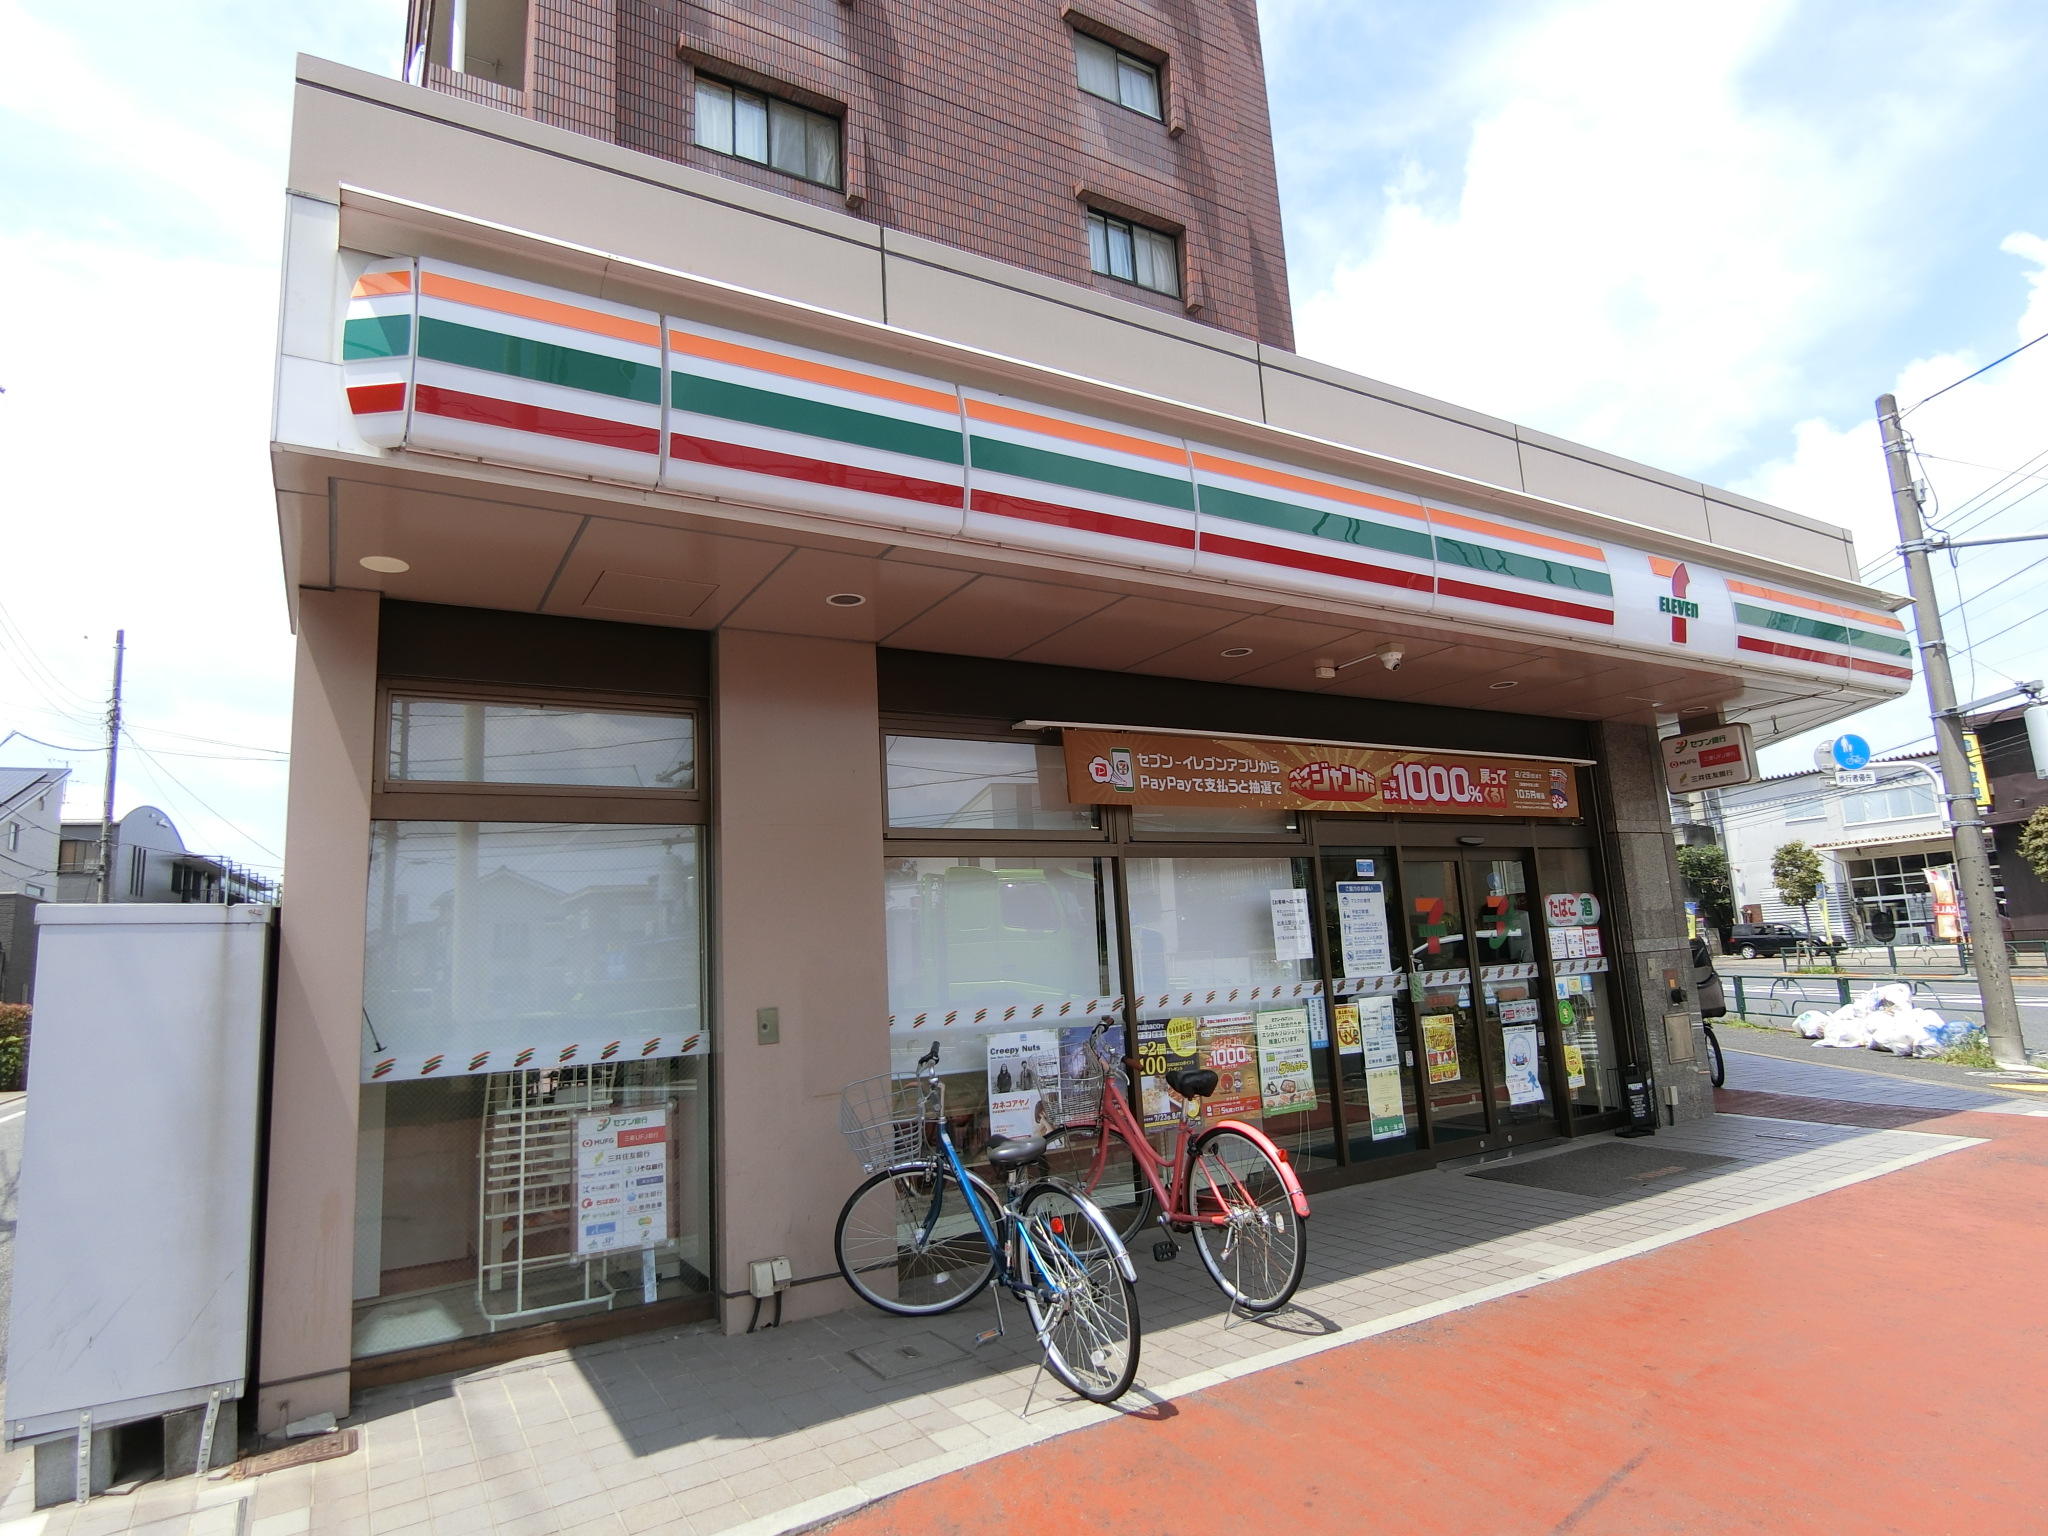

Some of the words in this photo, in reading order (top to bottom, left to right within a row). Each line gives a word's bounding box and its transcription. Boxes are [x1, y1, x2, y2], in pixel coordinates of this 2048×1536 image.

[1480, 768, 1507, 785] 戻って
[1838, 771, 1873, 784] 歩行者優先
[1140, 775, 1282, 795] PayPayで支払うと抽選で
[1548, 898, 1577, 918] たばこ
[1580, 898, 1593, 916] 酒
[990, 1047, 1019, 1056] Creepy
[1022, 1044, 1041, 1052] Nuts
[992, 1098, 1030, 1110] カネコアヤノ
[613, 1116, 648, 1126] セブン銀行
[594, 1137, 614, 1145] MUFG
[624, 1132, 659, 1142] 三菱UFJ銀行
[608, 1150, 650, 1162] 三井住友銀行
